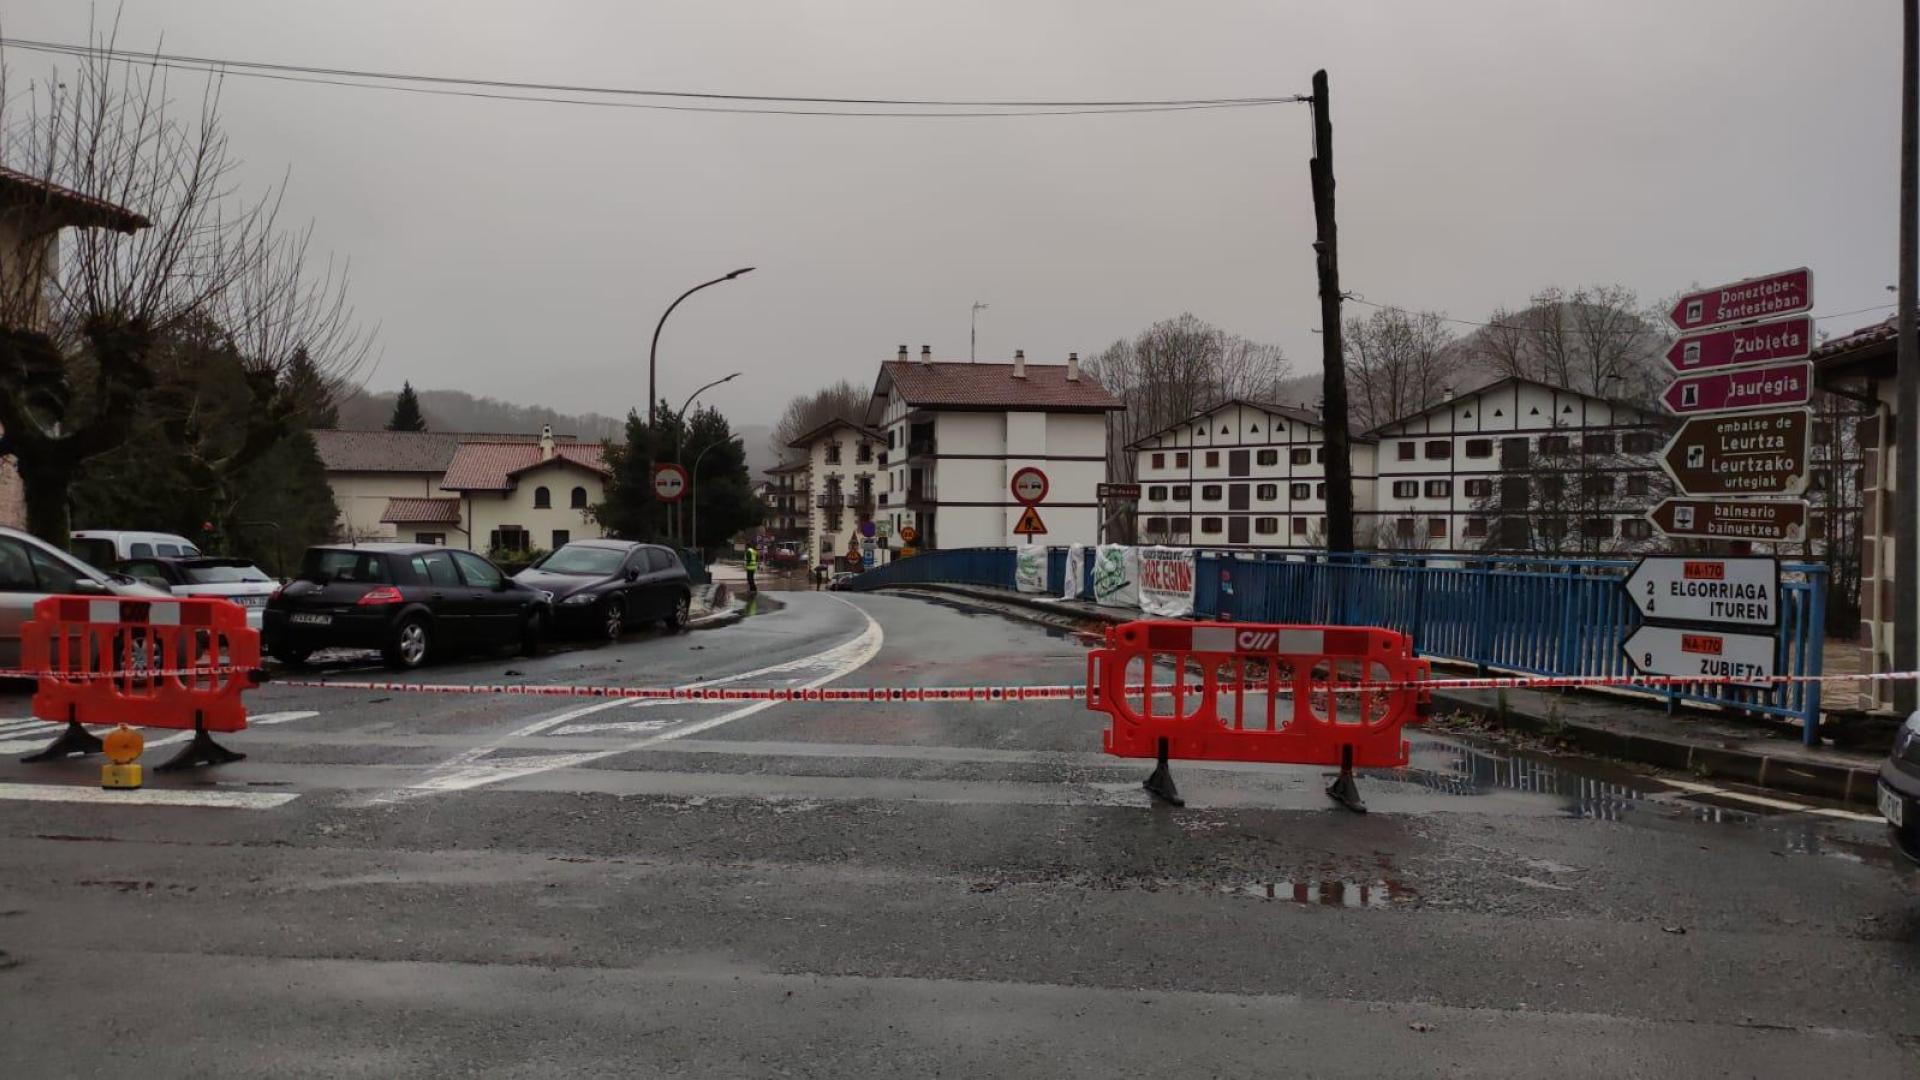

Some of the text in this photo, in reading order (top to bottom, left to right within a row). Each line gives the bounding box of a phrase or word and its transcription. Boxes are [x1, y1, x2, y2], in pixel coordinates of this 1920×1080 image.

[1717, 295, 1800, 320] Santesteban
[1734, 333, 1800, 354] Zubieta
[1728, 376, 1799, 397] Jauregia
[1717, 417, 1792, 433] embalse de
[1721, 434, 1784, 451] Leurtza
[1711, 455, 1795, 473] Leurtzako
[1725, 475, 1777, 489] urtegiak
[1714, 504, 1776, 519] balneario
[1708, 522, 1780, 536] bainuetxea
[1685, 564, 1723, 577] NA-170
[1646, 581, 1768, 600] 2 ELGORRIAGA
[1646, 598, 1768, 620] 4 ITUREN
[1683, 637, 1722, 652] NA-170
[1644, 652, 1764, 677] 8 ZUBIETA
